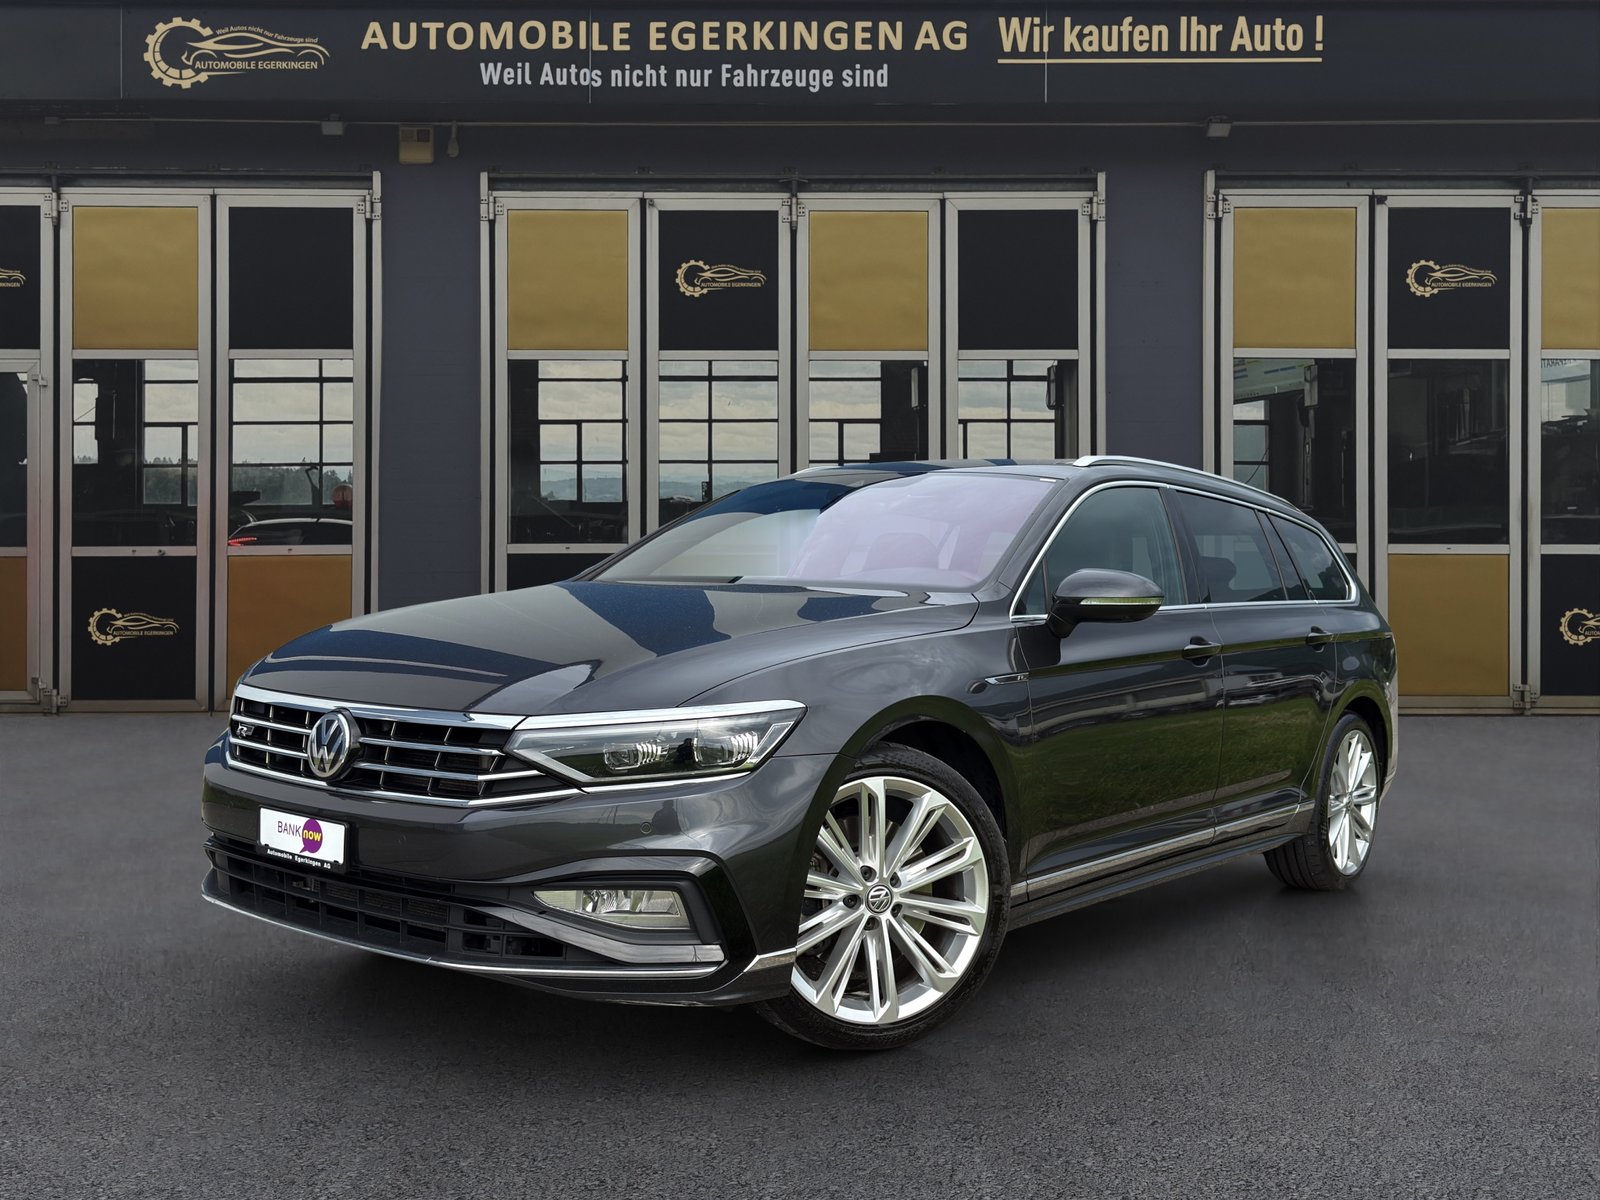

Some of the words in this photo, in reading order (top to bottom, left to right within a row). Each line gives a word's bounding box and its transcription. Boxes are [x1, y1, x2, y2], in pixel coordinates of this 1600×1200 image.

[216, 25, 230, 35] Weil
[248, 25, 264, 34] nicht
[274, 33, 305, 44] Fahrzeuge
[361, 20, 631, 51] AUTOMOBILE
[649, 20, 903, 51] EGERKINGEN
[914, 20, 967, 51] AG
[998, 16, 1054, 52] Wir
[1063, 16, 1168, 52] kaufen
[1179, 16, 1223, 51] Ihr
[1230, 16, 1303, 51] Auto
[195, 61, 256, 69] AUTOMOBILE
[258, 61, 318, 69] EGERKINGEN
[480, 62, 532, 86] Weil
[539, 63, 602, 88] Autos
[610, 64, 668, 88] nicht
[675, 67, 712, 88] nur
[721, 64, 834, 93] Fahrzeuge
[842, 64, 889, 88] sind
[277, 820, 302, 838] BANK
[303, 829, 322, 842] now
[266, 848, 292, 860] Automobile
[294, 855, 321, 867] Egerkingen
[323, 862, 331, 870] AG
